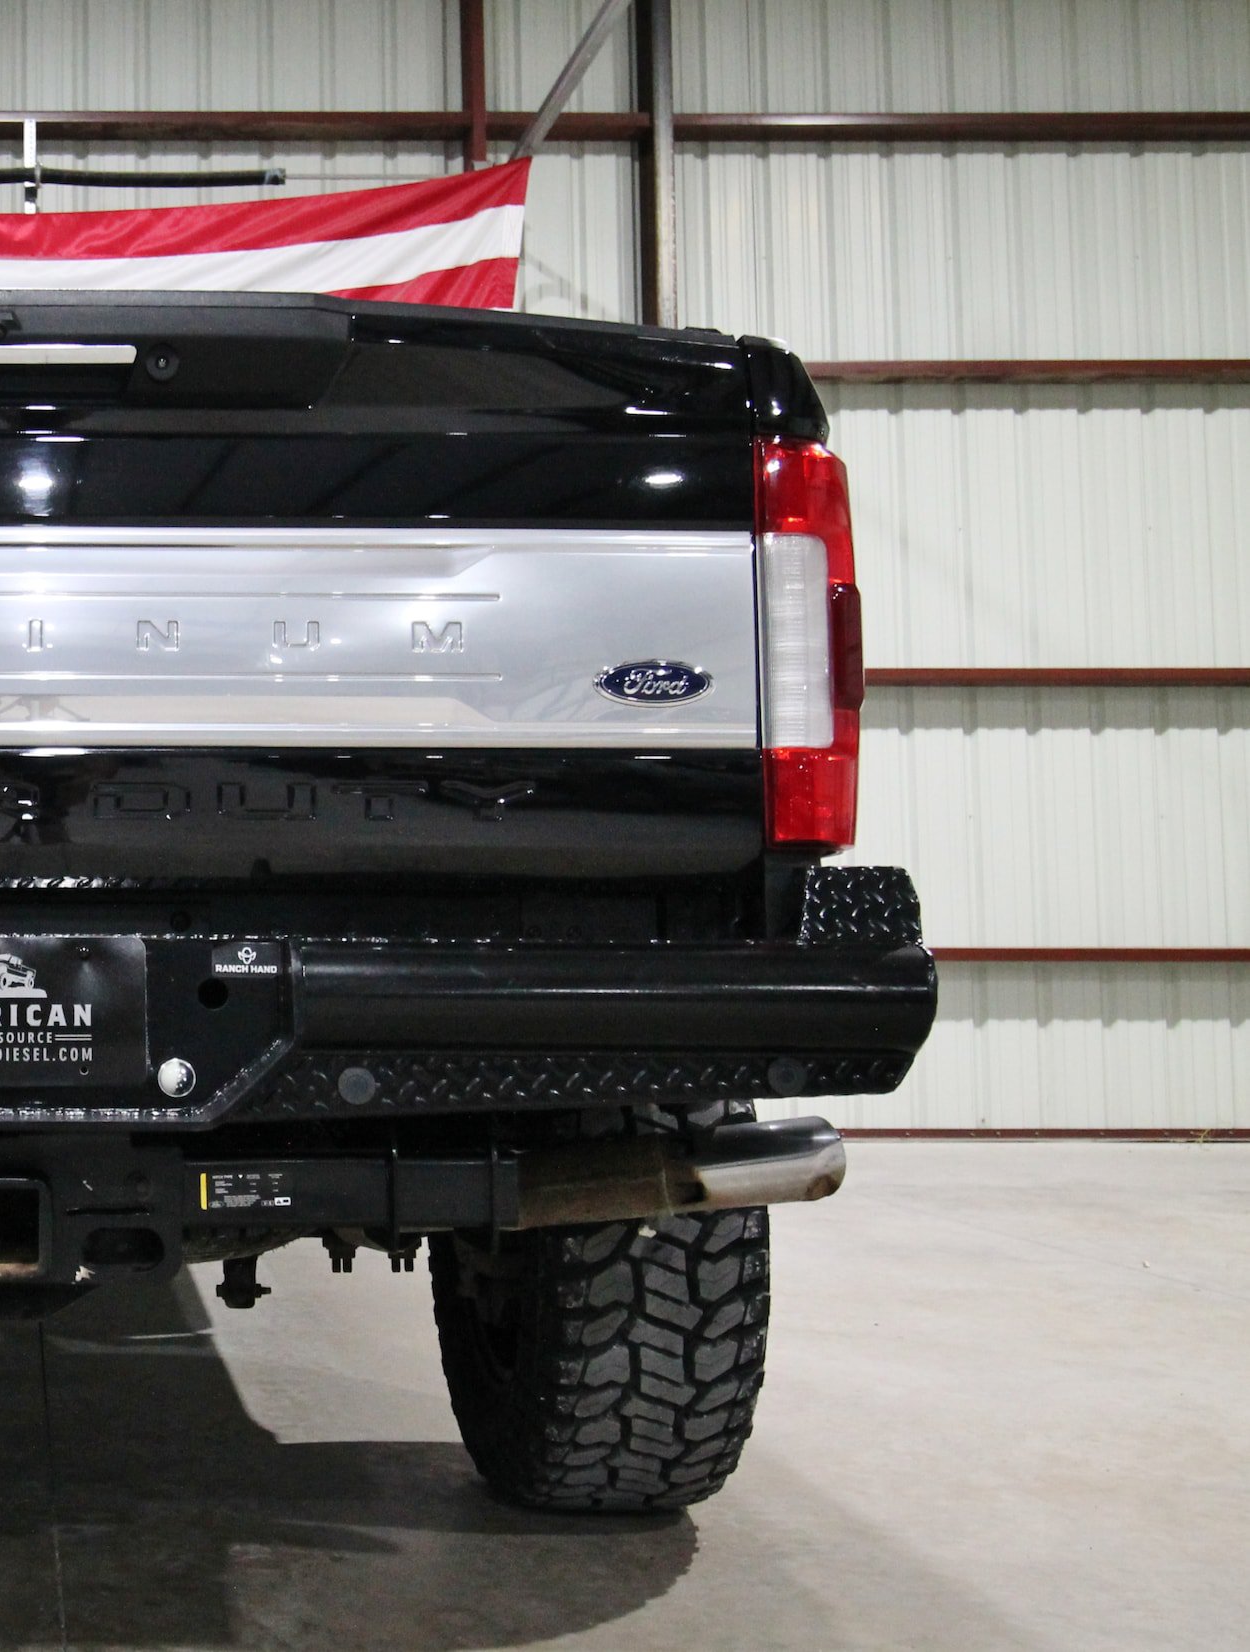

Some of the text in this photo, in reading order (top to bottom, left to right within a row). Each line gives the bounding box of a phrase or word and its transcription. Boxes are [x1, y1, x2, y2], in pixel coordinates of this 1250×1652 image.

[623, 668, 690, 695] Ford
[90, 779, 537, 821] DUTY
[215, 963, 278, 974] RANCH HAND
